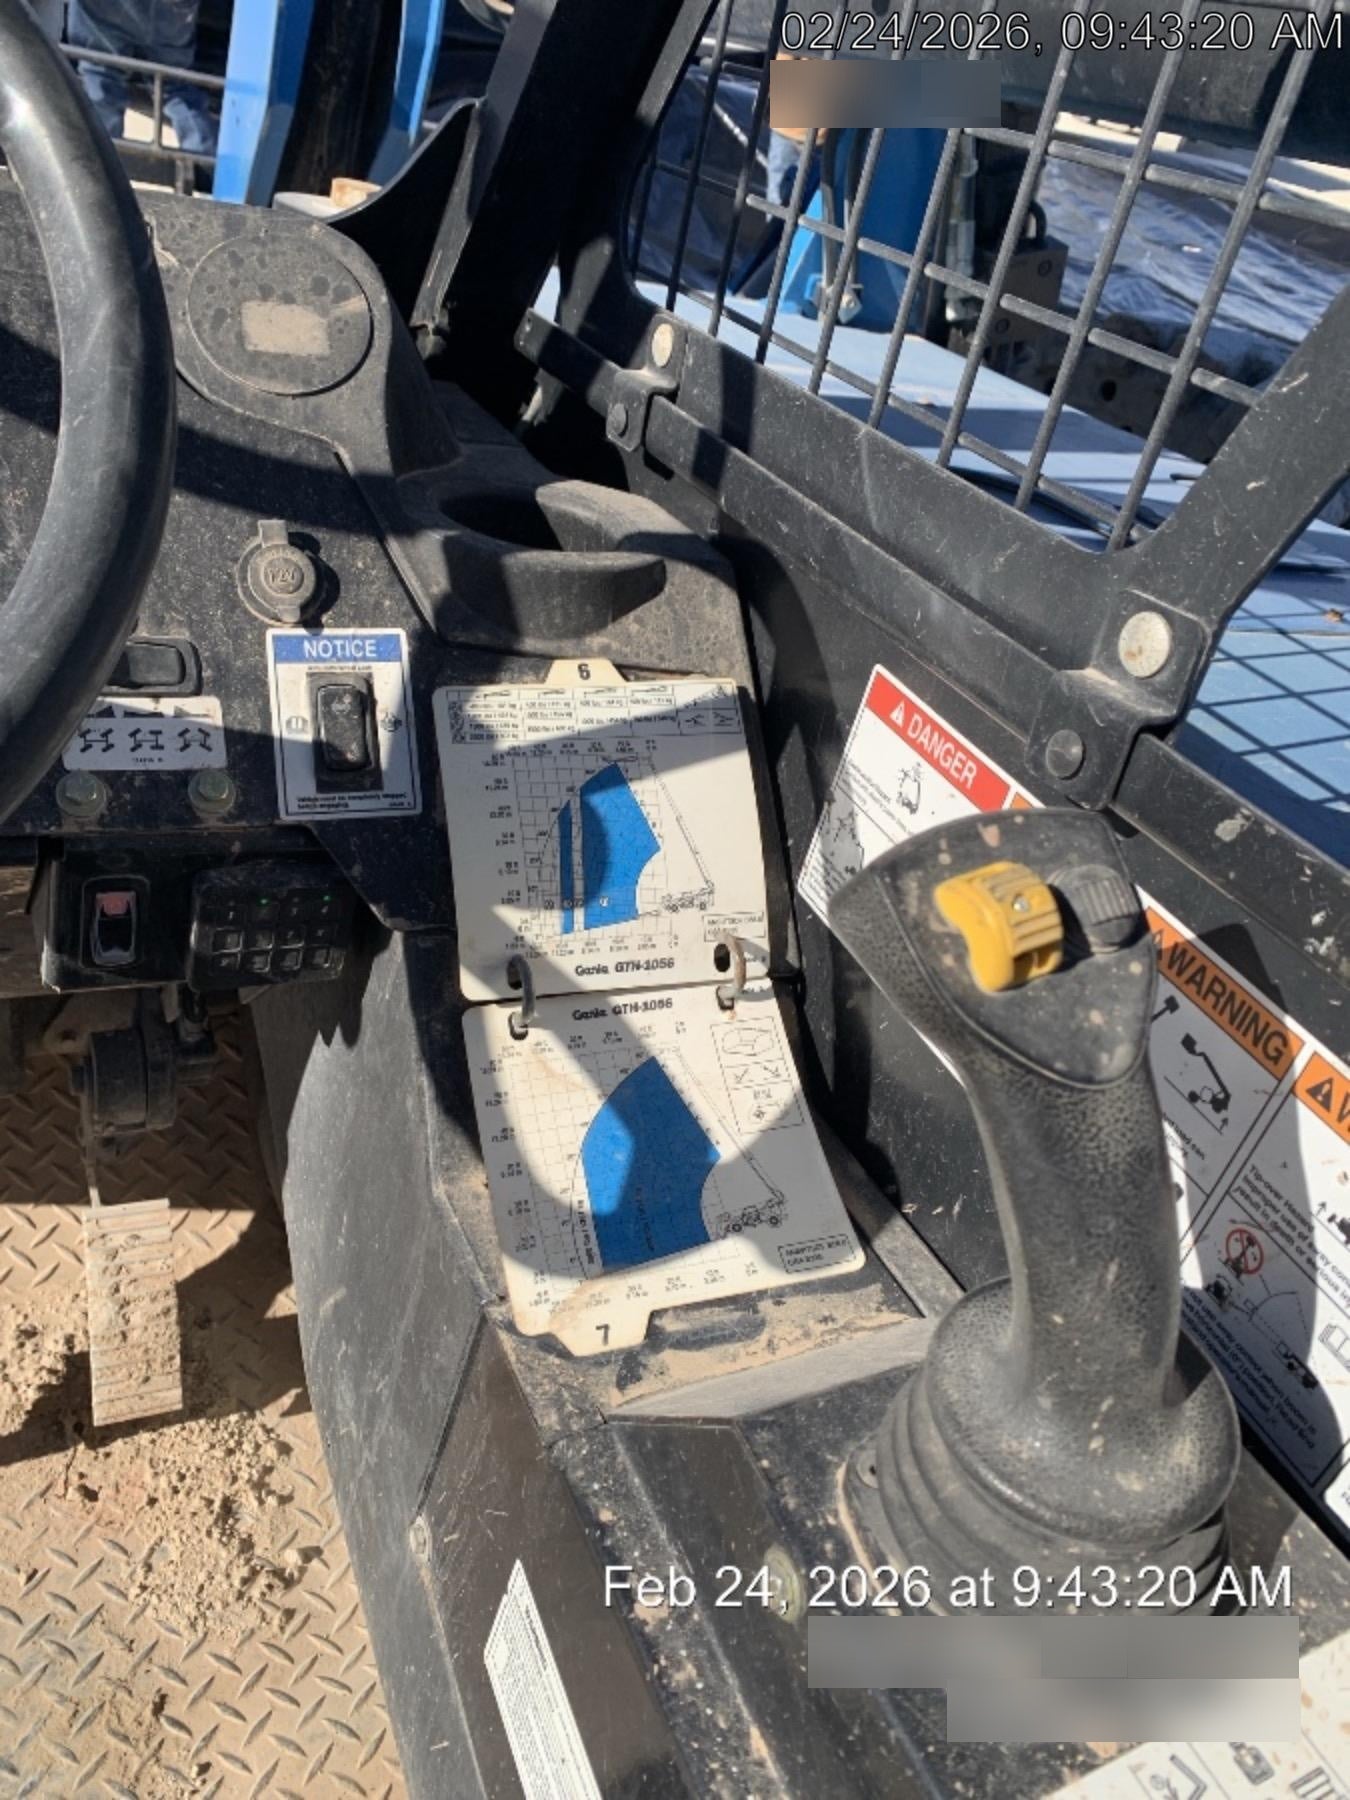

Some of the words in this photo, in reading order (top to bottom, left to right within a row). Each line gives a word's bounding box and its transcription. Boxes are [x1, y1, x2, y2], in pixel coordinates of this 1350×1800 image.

[304, 639, 377, 658] NOTICE
[578, 663, 590, 680] 6
[907, 713, 977, 790] DANGER
[575, 963, 609, 977] Genie
[615, 957, 675, 973] GTH-1056
[572, 1008, 608, 1020] Genie
[612, 997, 673, 1015] GTH-1056
[1167, 941, 1289, 1066] WARNING
[596, 1324, 609, 1346] 7
